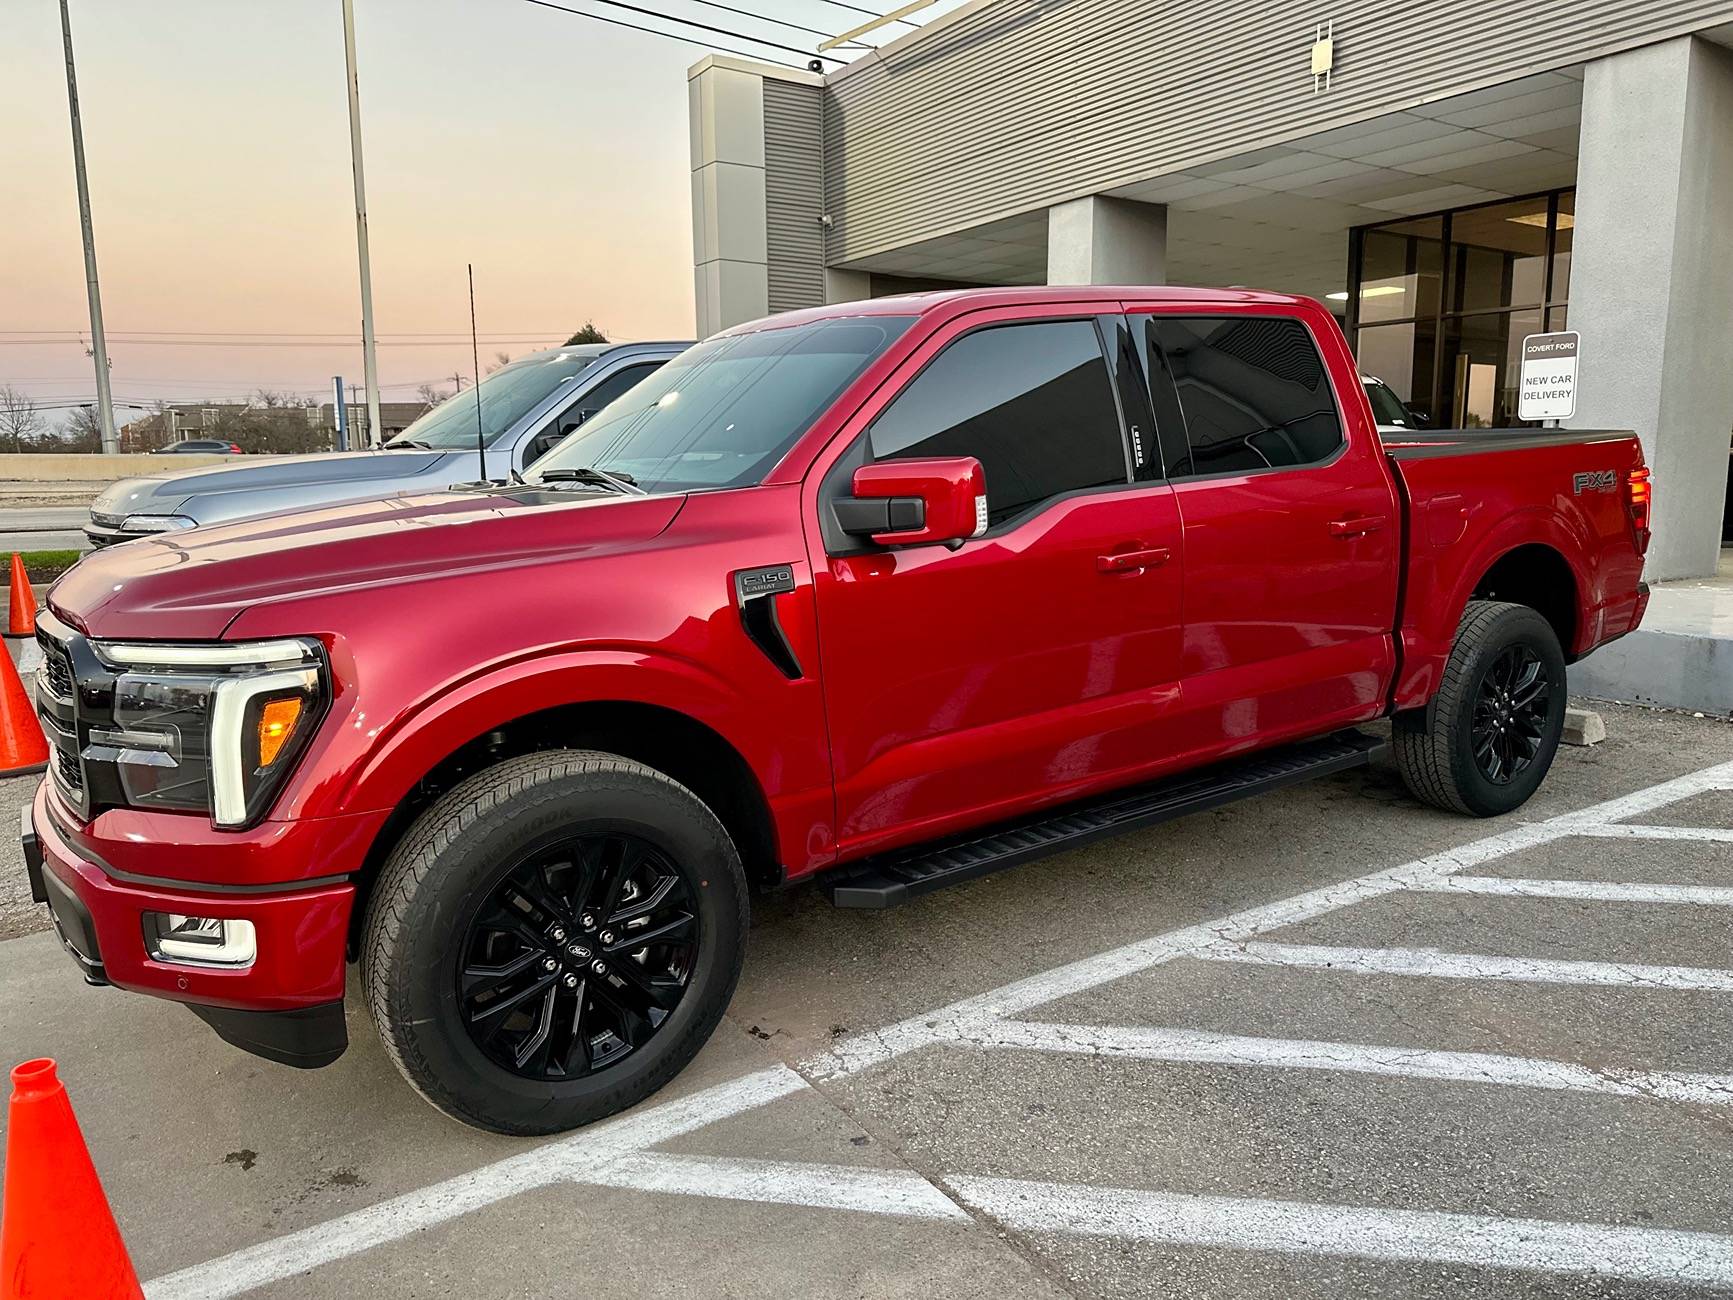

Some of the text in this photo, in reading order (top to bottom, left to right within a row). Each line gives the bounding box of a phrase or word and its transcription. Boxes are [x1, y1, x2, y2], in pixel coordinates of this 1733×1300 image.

[1527, 342, 1575, 353] COVERT FORD
[1525, 374, 1572, 385] NEW CAR
[1523, 390, 1572, 400] DELIVERY
[1573, 470, 1616, 496] FX4
[743, 571, 790, 585] F-150
